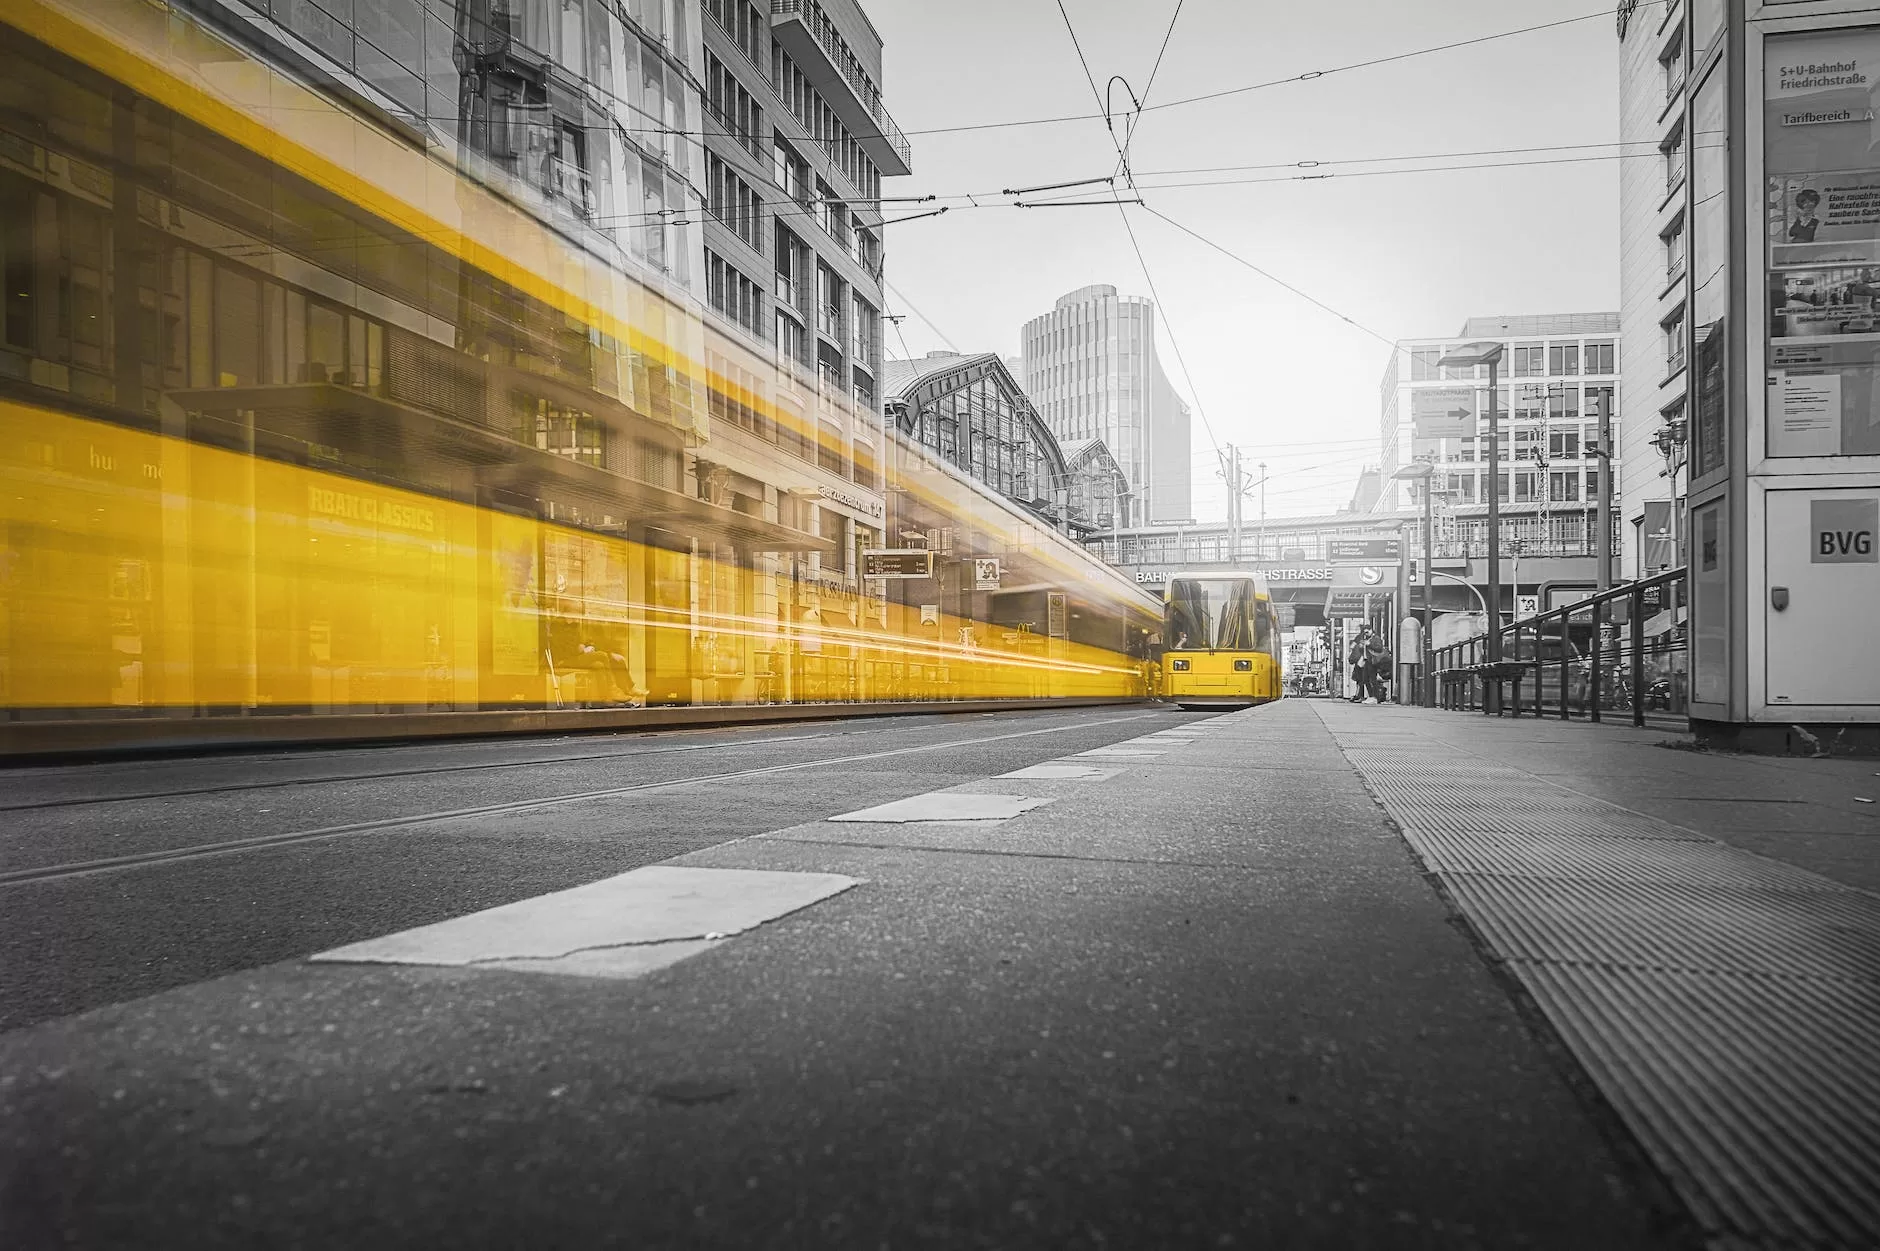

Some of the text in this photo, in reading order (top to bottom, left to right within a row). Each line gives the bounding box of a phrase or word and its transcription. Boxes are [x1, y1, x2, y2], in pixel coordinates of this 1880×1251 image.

[1780, 60, 1856, 76] S+U-Bahnhof
[1780, 73, 1867, 89] Friedrichstraße
[1784, 109, 1850, 124] Tarifbereich
[1819, 530, 1871, 555] BVG
[1136, 568, 1333, 583] BAHN HSTRASSE
